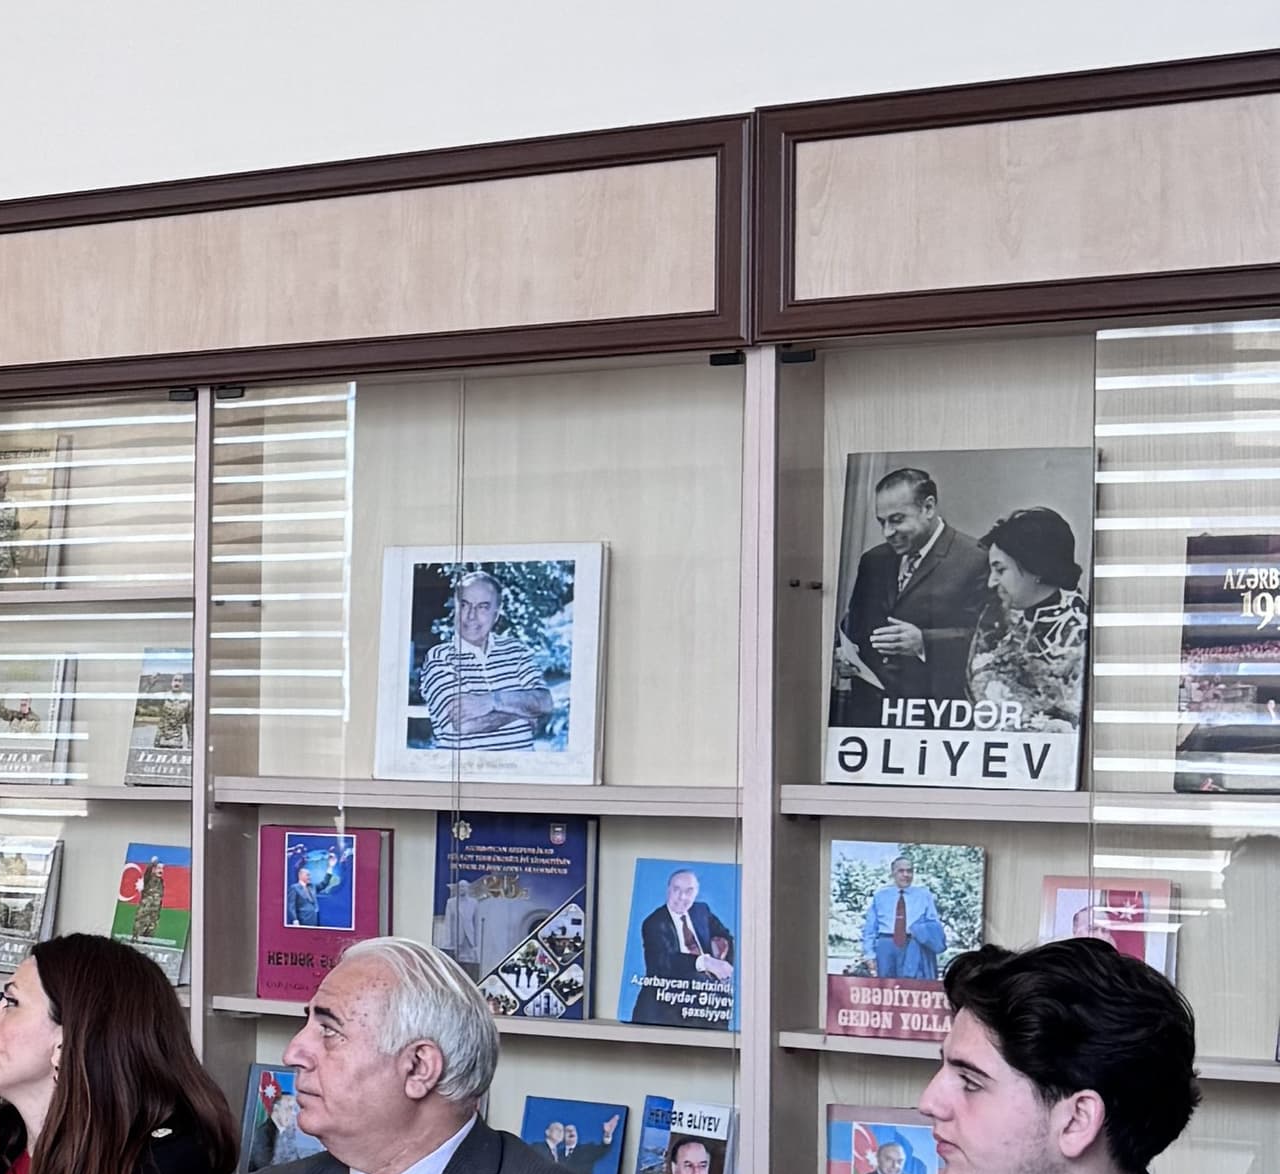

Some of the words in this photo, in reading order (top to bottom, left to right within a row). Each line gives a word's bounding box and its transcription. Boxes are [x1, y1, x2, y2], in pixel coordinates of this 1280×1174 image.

[1223, 567, 1280, 590] AZƏRB
[881, 699, 1023, 730] HEYDƏR
[838, 737, 1051, 779] ƏLİYEV
[631, 974, 689, 990] Azərbaycan
[656, 988, 696, 1005] Heydər
[698, 992, 734, 1009] Əliyev
[838, 1008, 894, 1029] GEDƏN
[899, 1012, 953, 1032] YOLLA
[686, 1110, 721, 1133] ƏLİYEV
